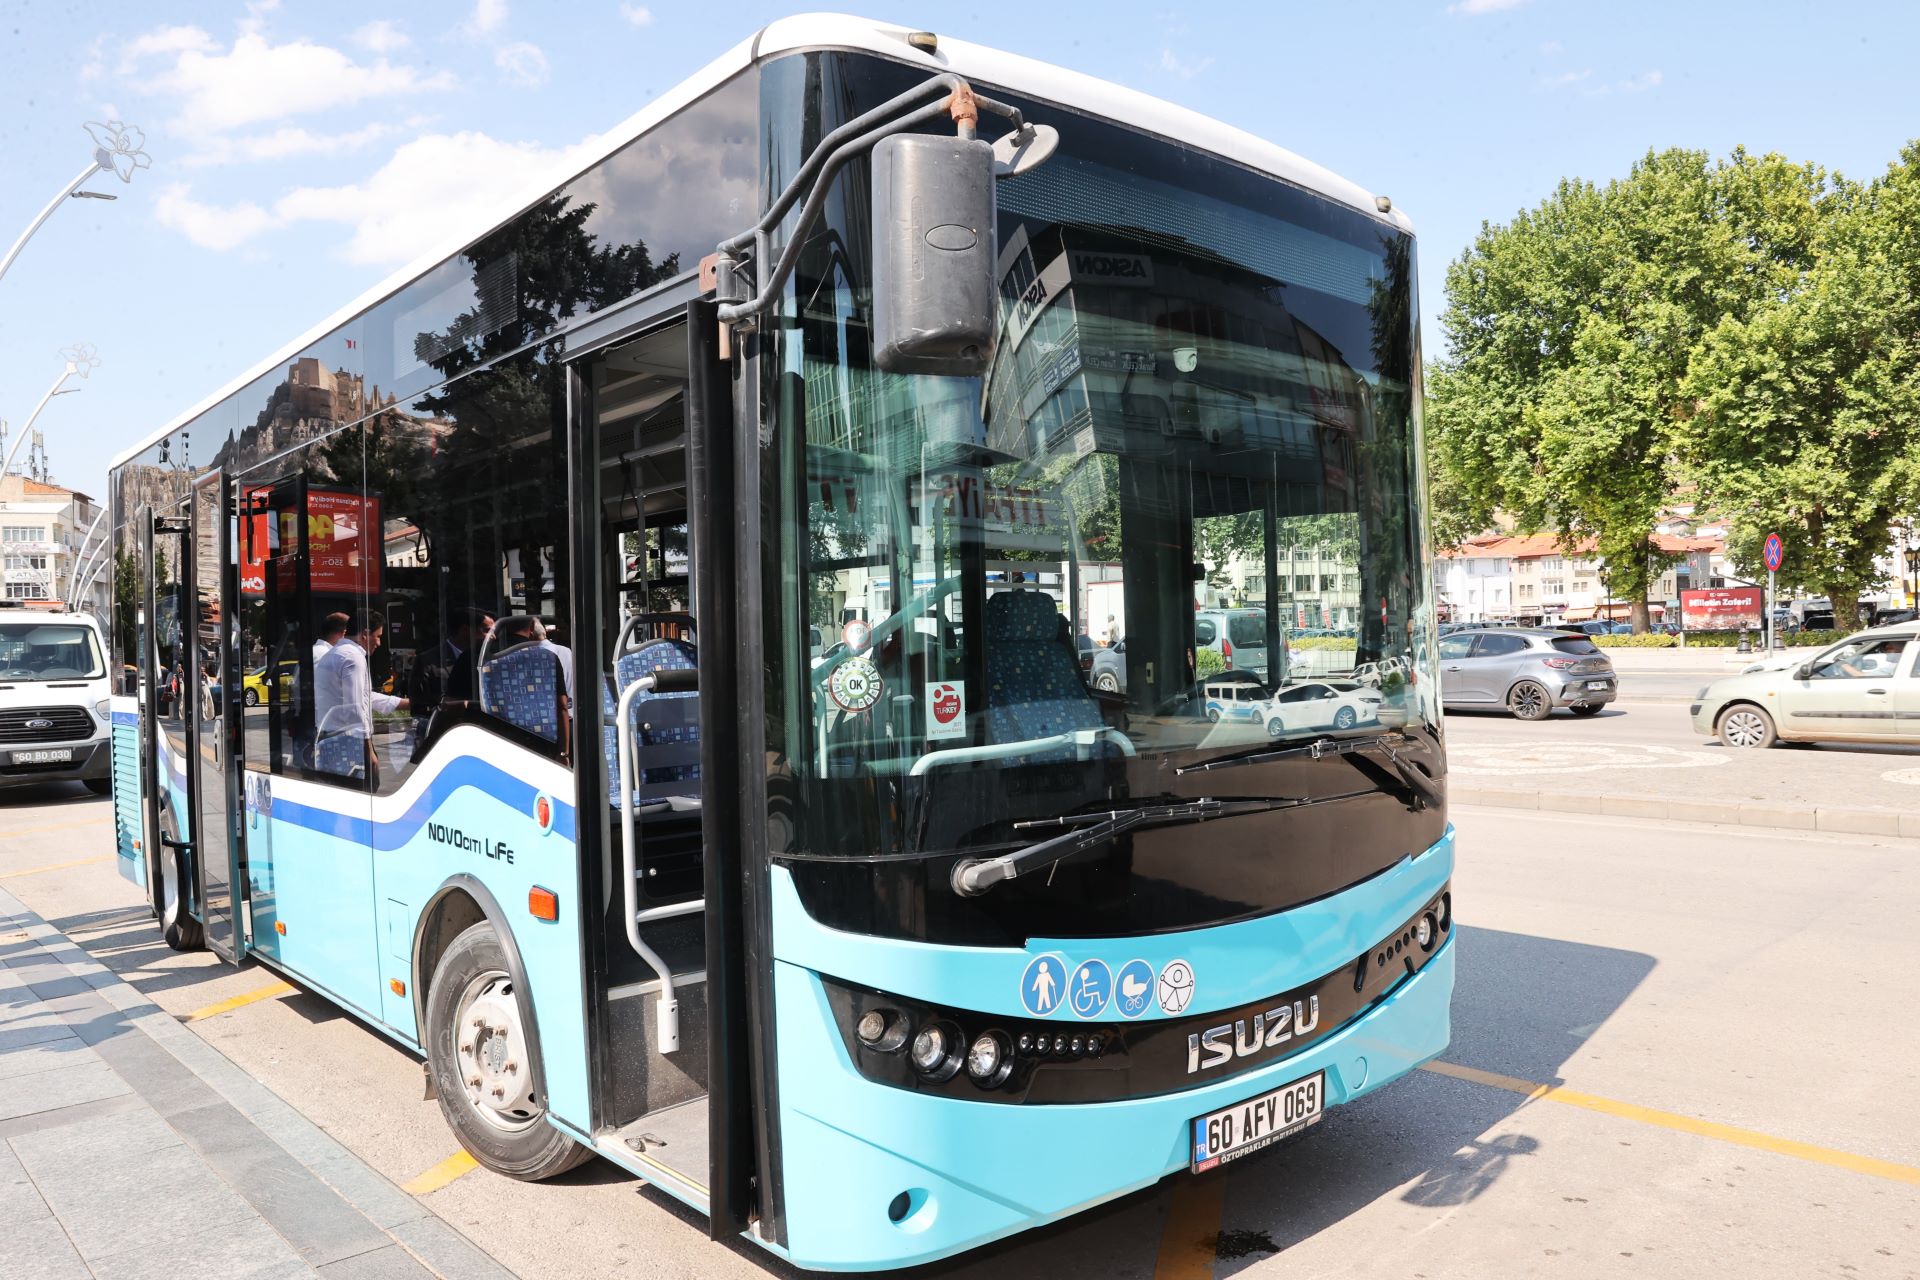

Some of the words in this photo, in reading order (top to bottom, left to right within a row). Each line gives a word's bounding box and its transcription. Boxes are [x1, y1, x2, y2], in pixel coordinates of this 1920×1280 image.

[849, 679, 863, 690] OK
[936, 706, 957, 714] TURKEY
[18, 752, 32, 761] 60
[35, 751, 48, 760] BD
[51, 750, 70, 759] 030
[1187, 994, 1319, 1074] ISUZU
[1208, 1113, 1233, 1154] 60
[1242, 1096, 1277, 1142] AFV
[1284, 1081, 1316, 1124] 069
[1196, 1144, 1206, 1155] TR
[1221, 1137, 1271, 1163] ÖZTOPRAKLAR
